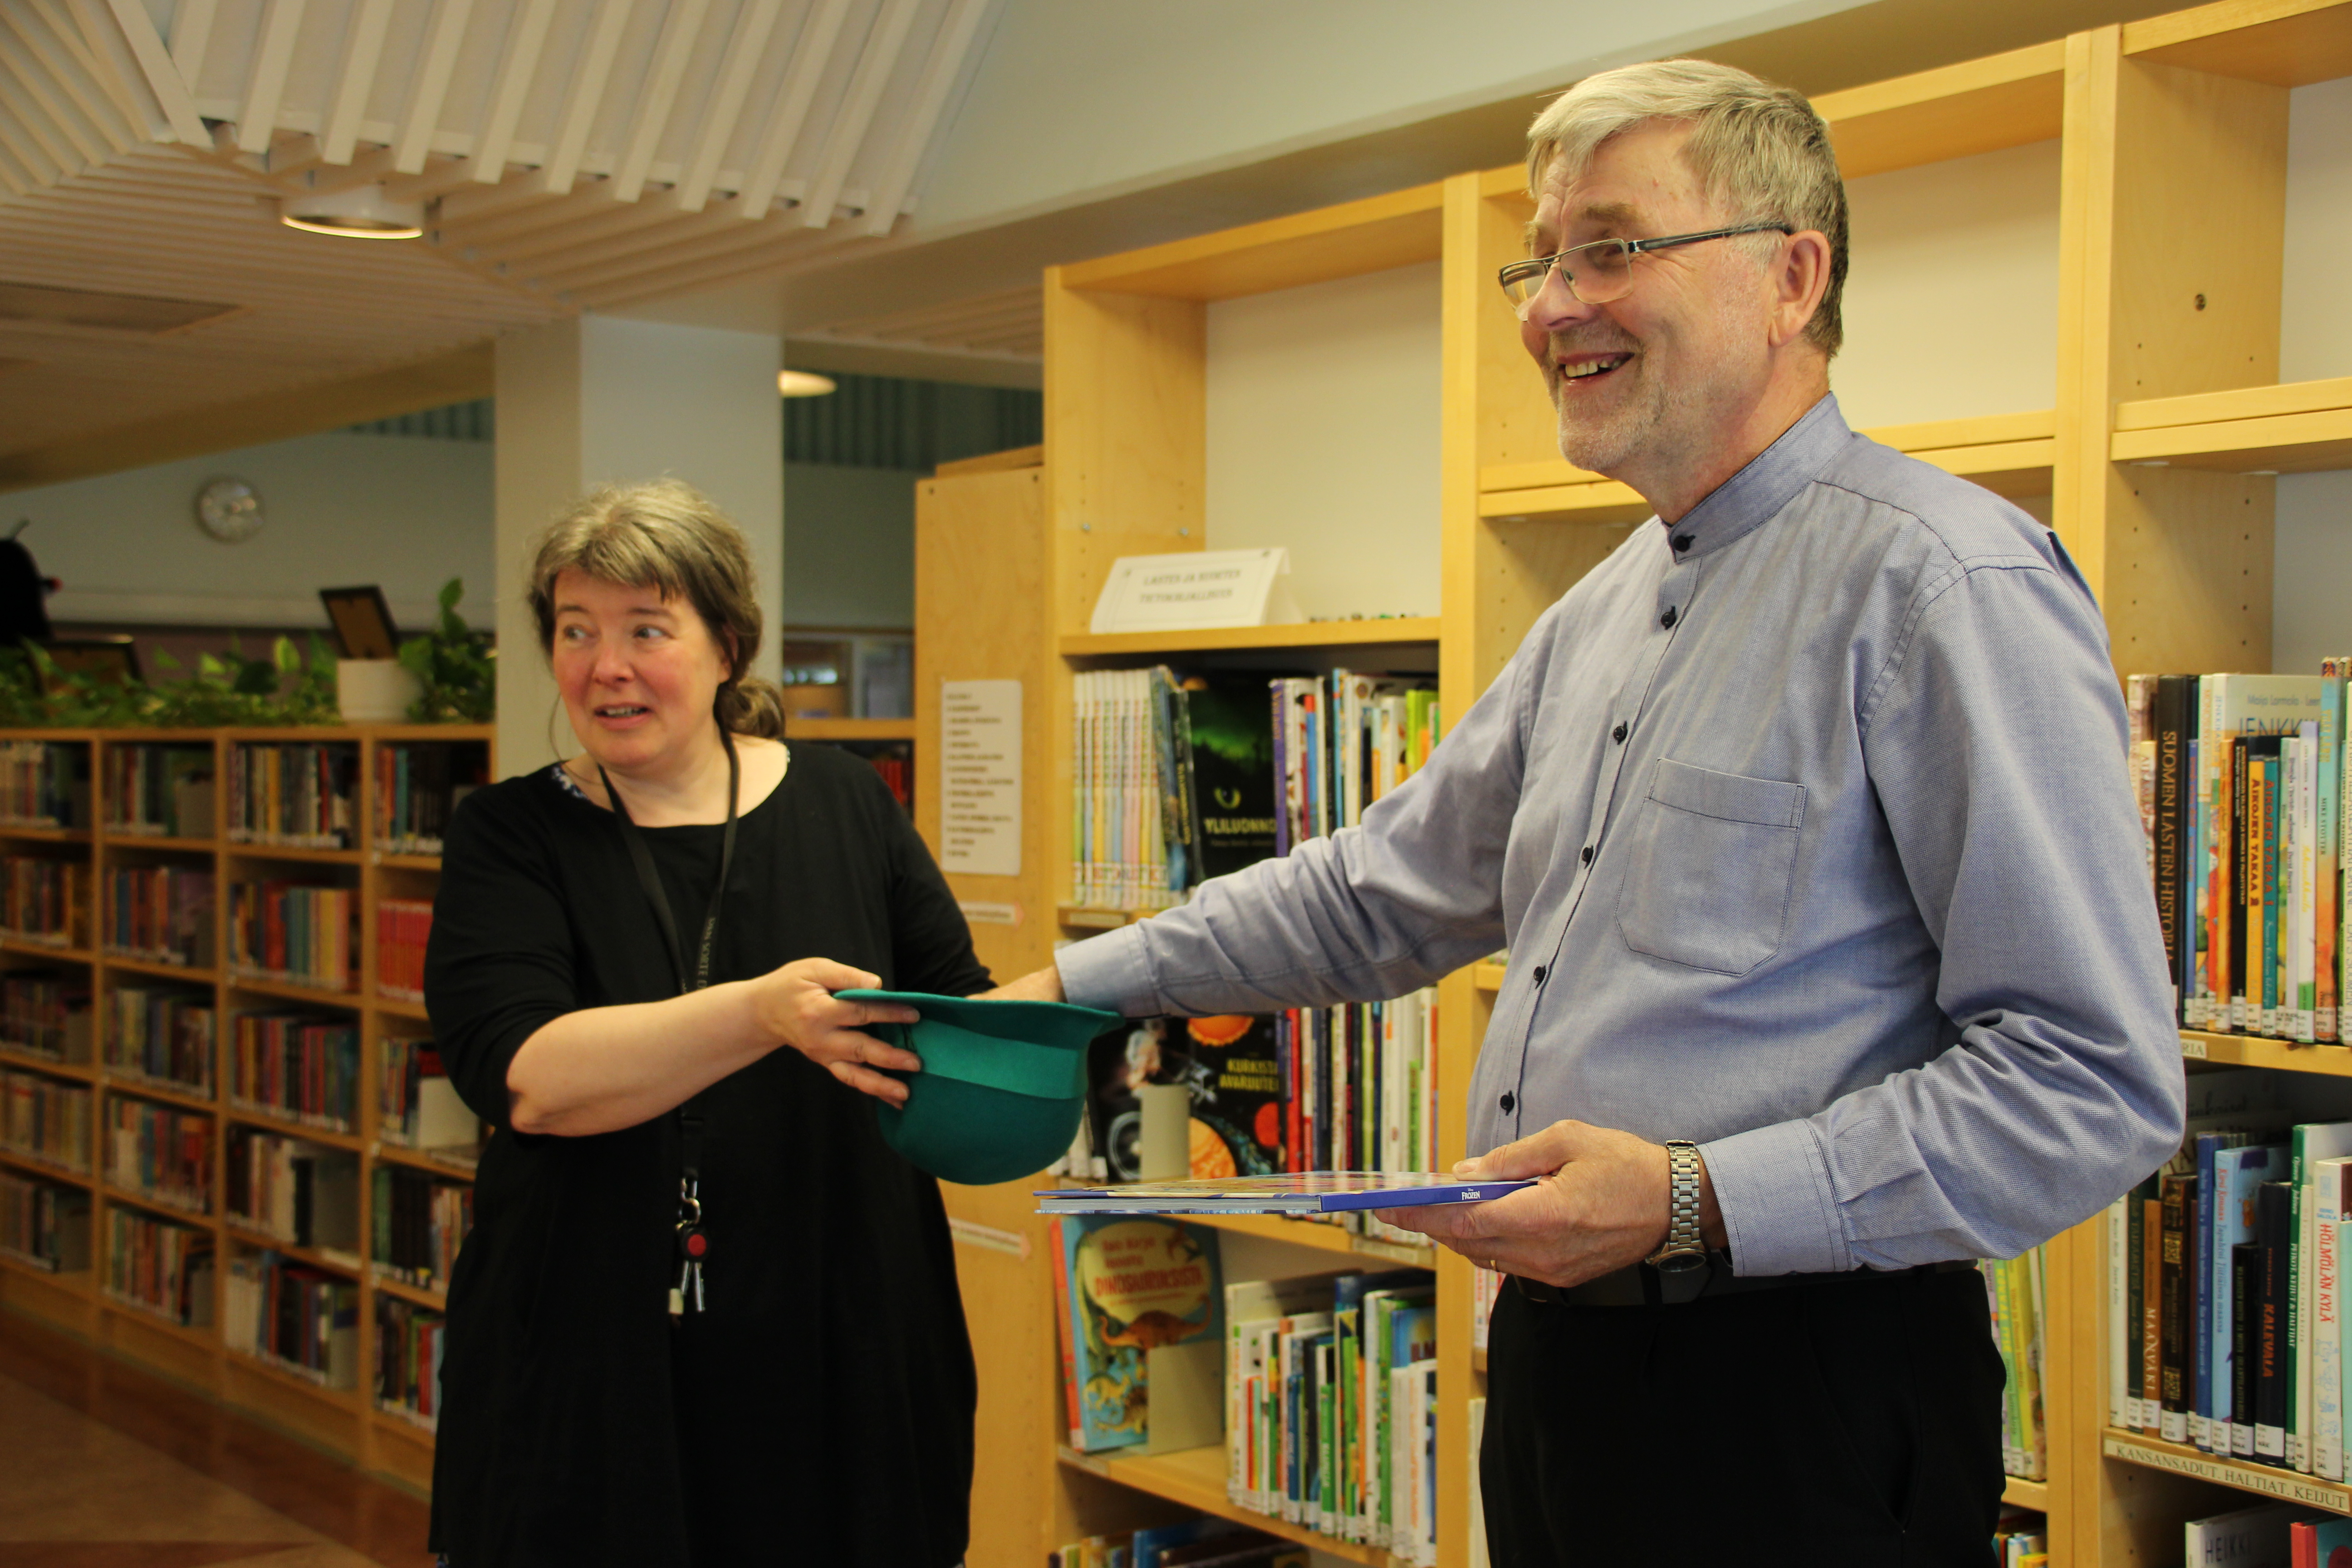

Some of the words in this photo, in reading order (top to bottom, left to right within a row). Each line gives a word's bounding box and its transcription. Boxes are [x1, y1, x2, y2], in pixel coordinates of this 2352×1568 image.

[2161, 731, 2177, 806] SUOMEN
[2251, 779, 2261, 838] AIKOJEN
[2264, 780, 2275, 840] AIKOJEN
[2160, 812, 2176, 876] LASTEN
[2319, 820, 2327, 855] STOTTER
[2250, 844, 2259, 892] TAKAA
[2264, 845, 2274, 892] TAKAA
[1461, 1191, 1480, 1200] FROZEN
[2318, 1224, 2335, 1290] HÖLMÖLÄN
[2289, 1275, 2298, 1302] KEIJUT
[2318, 1293, 2335, 1323] KYLÄ
[2143, 1308, 2159, 1390] MAANVÄKI
[2263, 1303, 2275, 1377] KALEVALA
[2288, 1312, 2297, 1348] HALTIJAT
[2294, 1485, 2345, 1508] KEIJUT
[2205, 1533, 2251, 1564] HEIKKI
